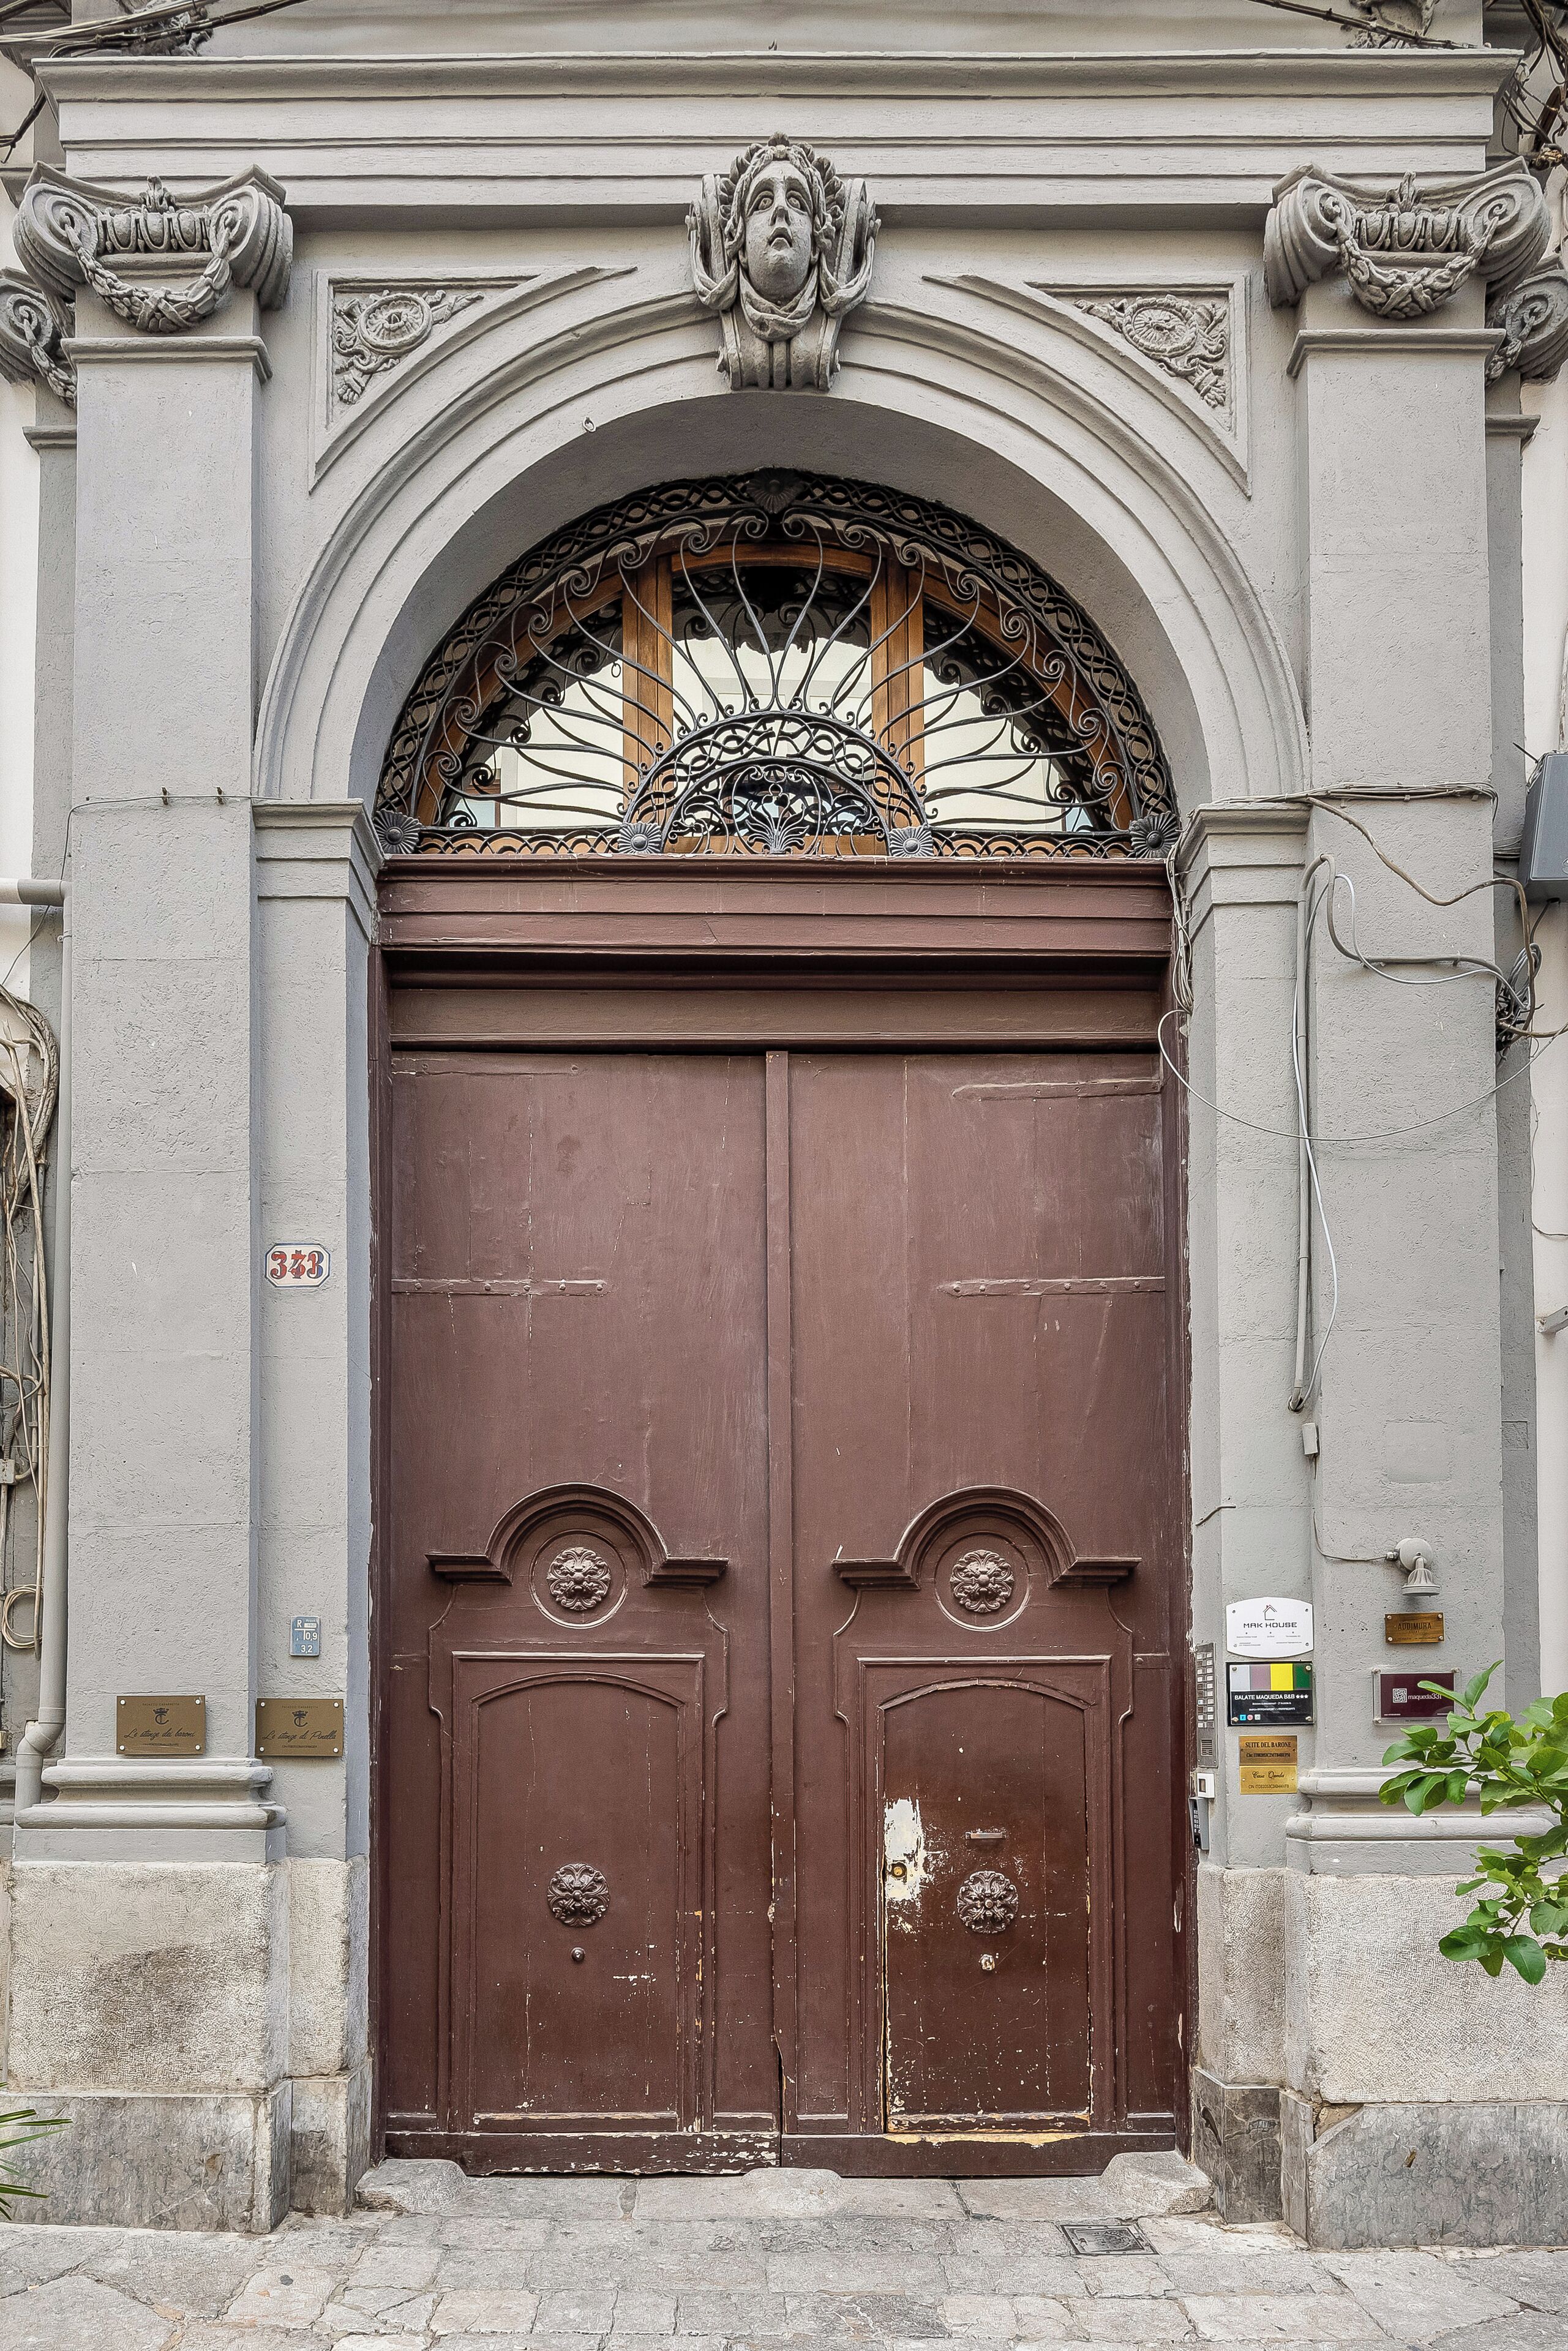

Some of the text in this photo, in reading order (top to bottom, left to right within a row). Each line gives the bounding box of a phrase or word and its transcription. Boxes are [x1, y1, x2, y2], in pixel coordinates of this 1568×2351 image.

[297, 1619, 302, 1628] R
[1398, 1622, 1432, 1630] ADDIMURA
[124, 1728, 138, 1738] Le
[262, 1730, 276, 1740] Le
